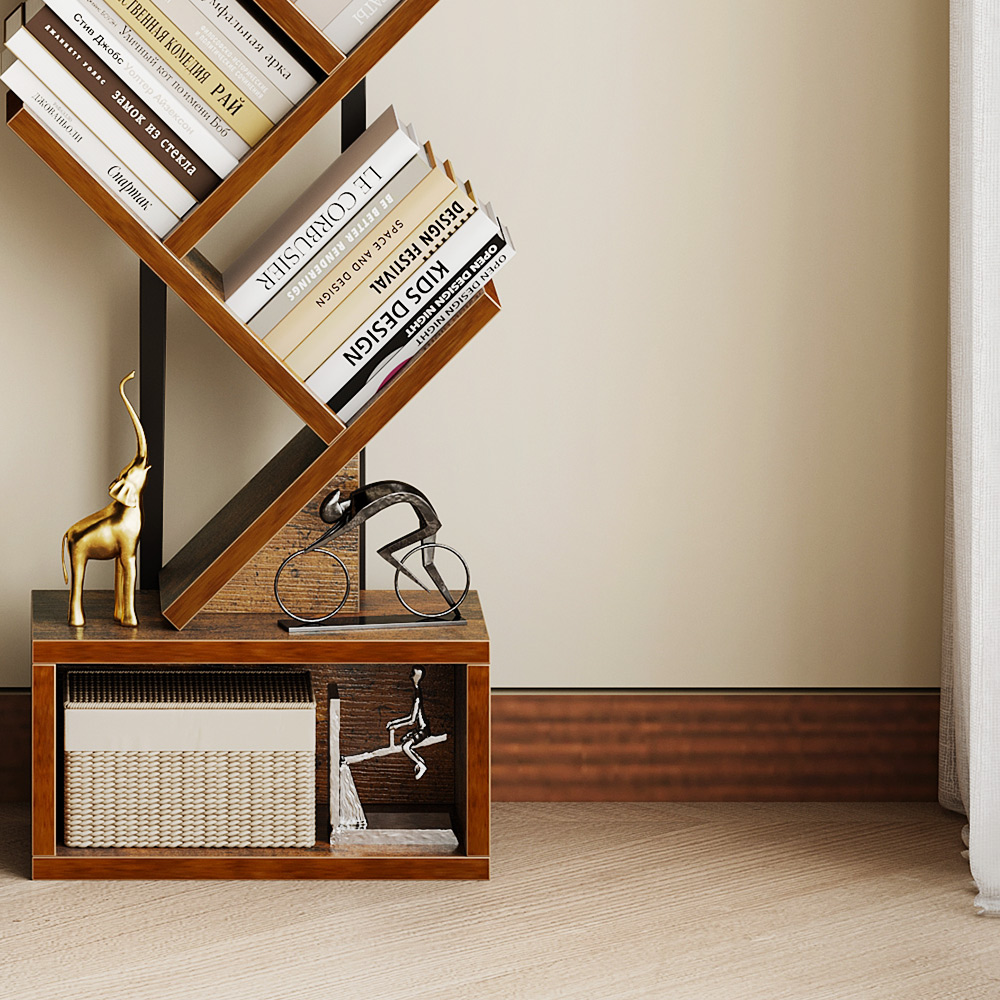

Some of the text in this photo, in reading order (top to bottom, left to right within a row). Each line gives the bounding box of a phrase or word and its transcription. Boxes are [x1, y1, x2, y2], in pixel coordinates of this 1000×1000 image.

[73, 13, 194, 135] Стив Джобс Уолтер Айзексон
[118, 24, 233, 137] Уличный кот по имени Боб
[163, 36, 211, 84] КОМЕДИЯ
[209, 83, 245, 116] РАЙ
[264, 55, 291, 79] арка
[107, 165, 152, 210] Спартак
[144, 123, 160, 139] из
[160, 138, 196, 175] стекла
[255, 165, 381, 290] LE CORBUSIER
[286, 193, 393, 301] BE BETTER RENDERINGS
[315, 219, 403, 307] SPACE AND DESIGN
[368, 200, 464, 294] DESIGN FESTIVAL
[342, 259, 449, 366] KIDS DESIGN
[405, 244, 497, 337] OPEN DESIGN NIGHT
[415, 254, 506, 346] OPEN DESIGN NIGHT
